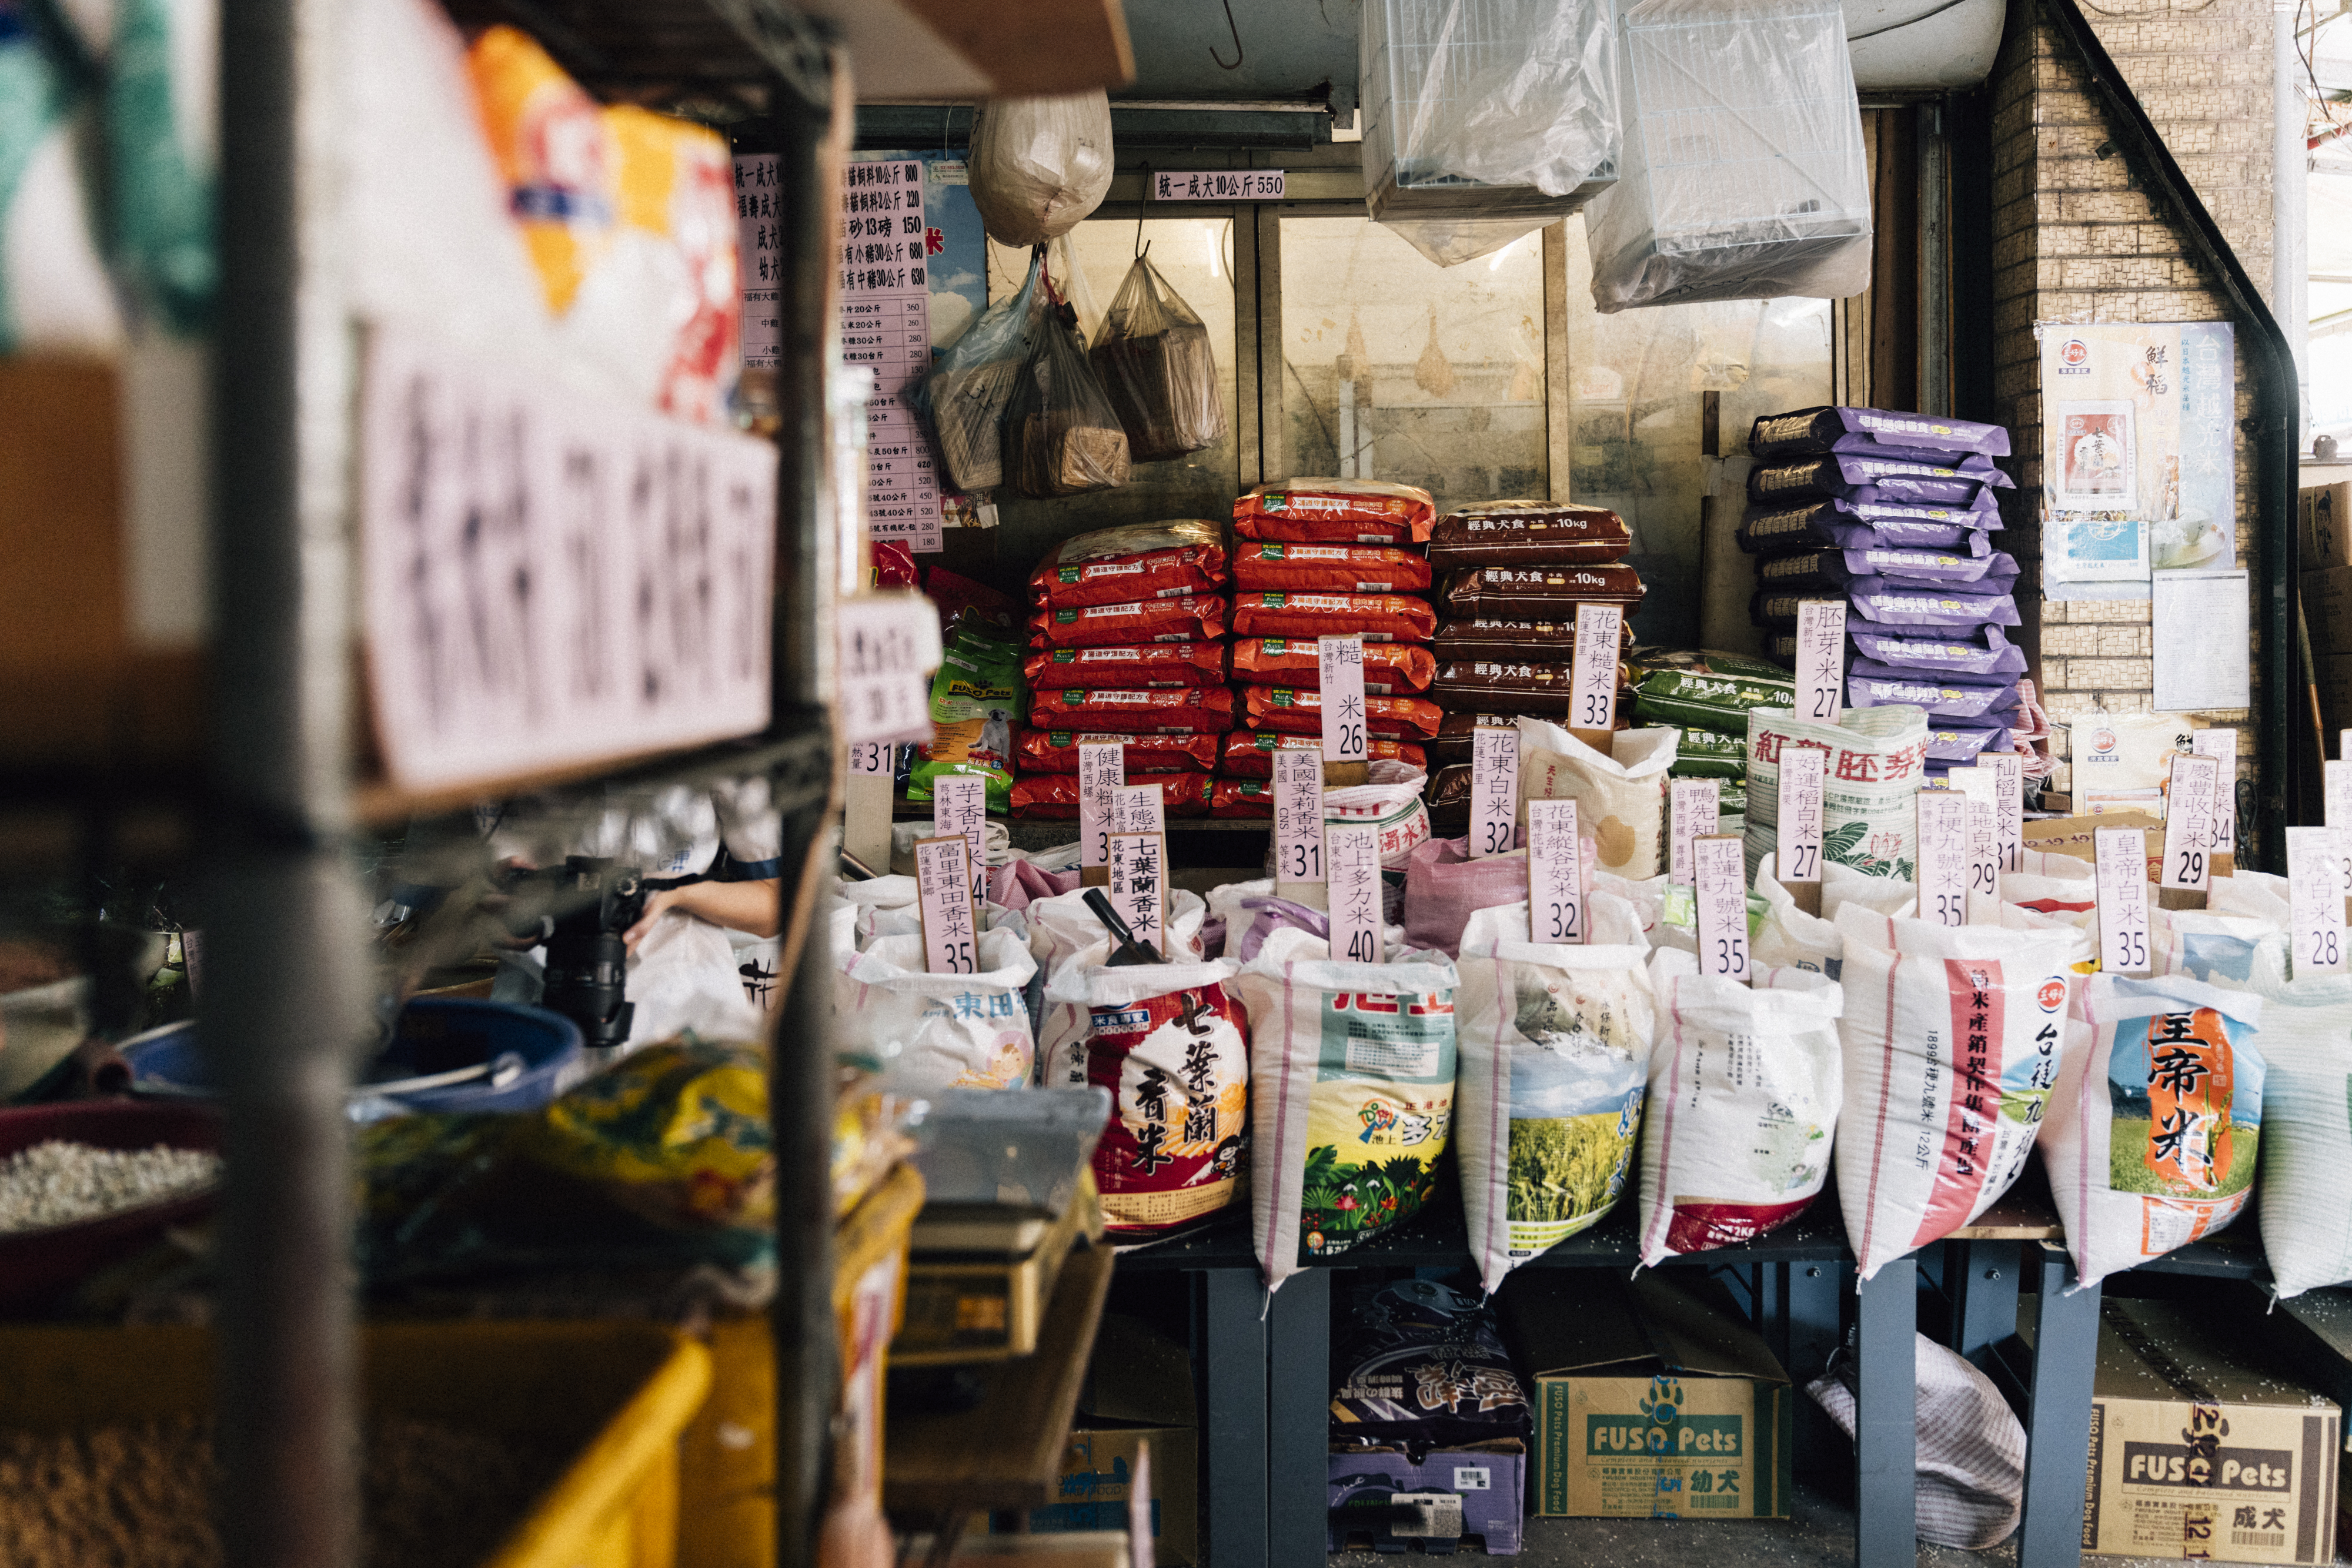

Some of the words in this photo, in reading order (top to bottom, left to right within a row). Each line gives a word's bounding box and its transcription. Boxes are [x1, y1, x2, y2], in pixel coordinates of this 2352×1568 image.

[905, 165, 918, 182] 800
[1159, 174, 1253, 198] 統一成犬10公斤
[1257, 176, 1282, 193] 550
[907, 190, 919, 208] 220
[903, 216, 921, 233] 150
[910, 242, 923, 259] 680
[911, 268, 924, 285] 630
[2146, 345, 2168, 396] 鮮稻
[2181, 339, 2190, 411] 以日本越光米品種
[1859, 416, 1929, 433] 福壽喵喵貓食
[916, 446, 930, 454] 800
[1468, 519, 1525, 530] 經典犬食
[1557, 519, 1587, 529] 10kg
[1093, 565, 1138, 573] 腸道守護配方
[1866, 551, 1936, 566] 福壽喵喵貓食
[1485, 570, 1543, 582] 經典犬食
[1575, 573, 1605, 586] 10kg
[1090, 605, 1136, 614] 腸道守護配方
[1577, 609, 1591, 656] 花蓮富里
[1802, 606, 1814, 648] 台灣新竹
[1585, 610, 1617, 690] 花東糙米
[1814, 606, 1842, 683] 胚芽米
[1323, 641, 1334, 684] 台灣新竹
[1474, 663, 1532, 678] 經典犬食
[952, 684, 983, 696] FUSO
[1335, 640, 1364, 720] 糙米
[1584, 694, 1608, 725] 33
[1813, 688, 1838, 718] 27
[1339, 724, 1362, 754] 26
[866, 742, 891, 772] 31
[1083, 748, 1094, 798] 台灣西螺
[1277, 754, 1287, 783] 美國
[1474, 733, 1486, 784] 花蓮玉里
[1485, 734, 1514, 817] 花東白米
[940, 784, 952, 830] 芎林東海
[1290, 753, 1319, 840] 美國茉莉香米
[1675, 788, 1686, 837] 台灣西螺
[1794, 755, 1820, 840] 好運稻白米
[2180, 764, 2215, 848] 慶豐收白米
[1485, 821, 1509, 854] 32
[1531, 805, 1544, 859] 台灣花蓮
[1969, 801, 1996, 858] 道地白米
[1098, 832, 1108, 862] 3
[1294, 844, 1319, 877] 31
[1330, 833, 1342, 882] 台東池上
[1546, 804, 1578, 897] 花東縱谷好米
[1793, 845, 1817, 878] 27
[918, 845, 935, 897] 花蓮富里鄉
[1111, 840, 1124, 894] 花東地區
[1344, 833, 1375, 925] 池上多力米
[1675, 844, 1685, 885] 尊爵一
[1973, 863, 1994, 895] 29
[2115, 834, 2145, 925] 皇帝白米
[2178, 851, 2203, 884] 29
[936, 842, 972, 938] 富里東田香米
[1128, 838, 1160, 932] 七葉蘭香米
[1712, 841, 1745, 933] 花蓮九號米
[1551, 902, 1577, 937] 32
[1937, 895, 1961, 927] 35
[944, 942, 973, 974] 35
[1348, 930, 1374, 962] 40
[1717, 939, 1744, 974] 35
[2119, 932, 2146, 966] 35
[2313, 931, 2337, 965] 28
[1172, 994, 1221, 1144] 七葉蘭
[1131, 1069, 1174, 1176] 香米
[1372, 1134, 1396, 1144] 池上
[1553, 1385, 1563, 1407] FUSO
[1553, 1410, 1563, 1430] Pets
[1552, 1430, 1563, 1470] Premium
[1594, 1427, 1668, 1451] FUSO
[1679, 1427, 1737, 1451] Pets
[1551, 1472, 1563, 1489] Dog
[1690, 1470, 1739, 1493] 幼犬
[2085, 1458, 2097, 1501] Premium
[2222, 1460, 2286, 1487] Pets
[1552, 1491, 1562, 1512] Food
[2084, 1503, 2094, 1522] Dog
[2233, 1506, 2286, 1530] 成犬
[2082, 1523, 2093, 1546] Food
